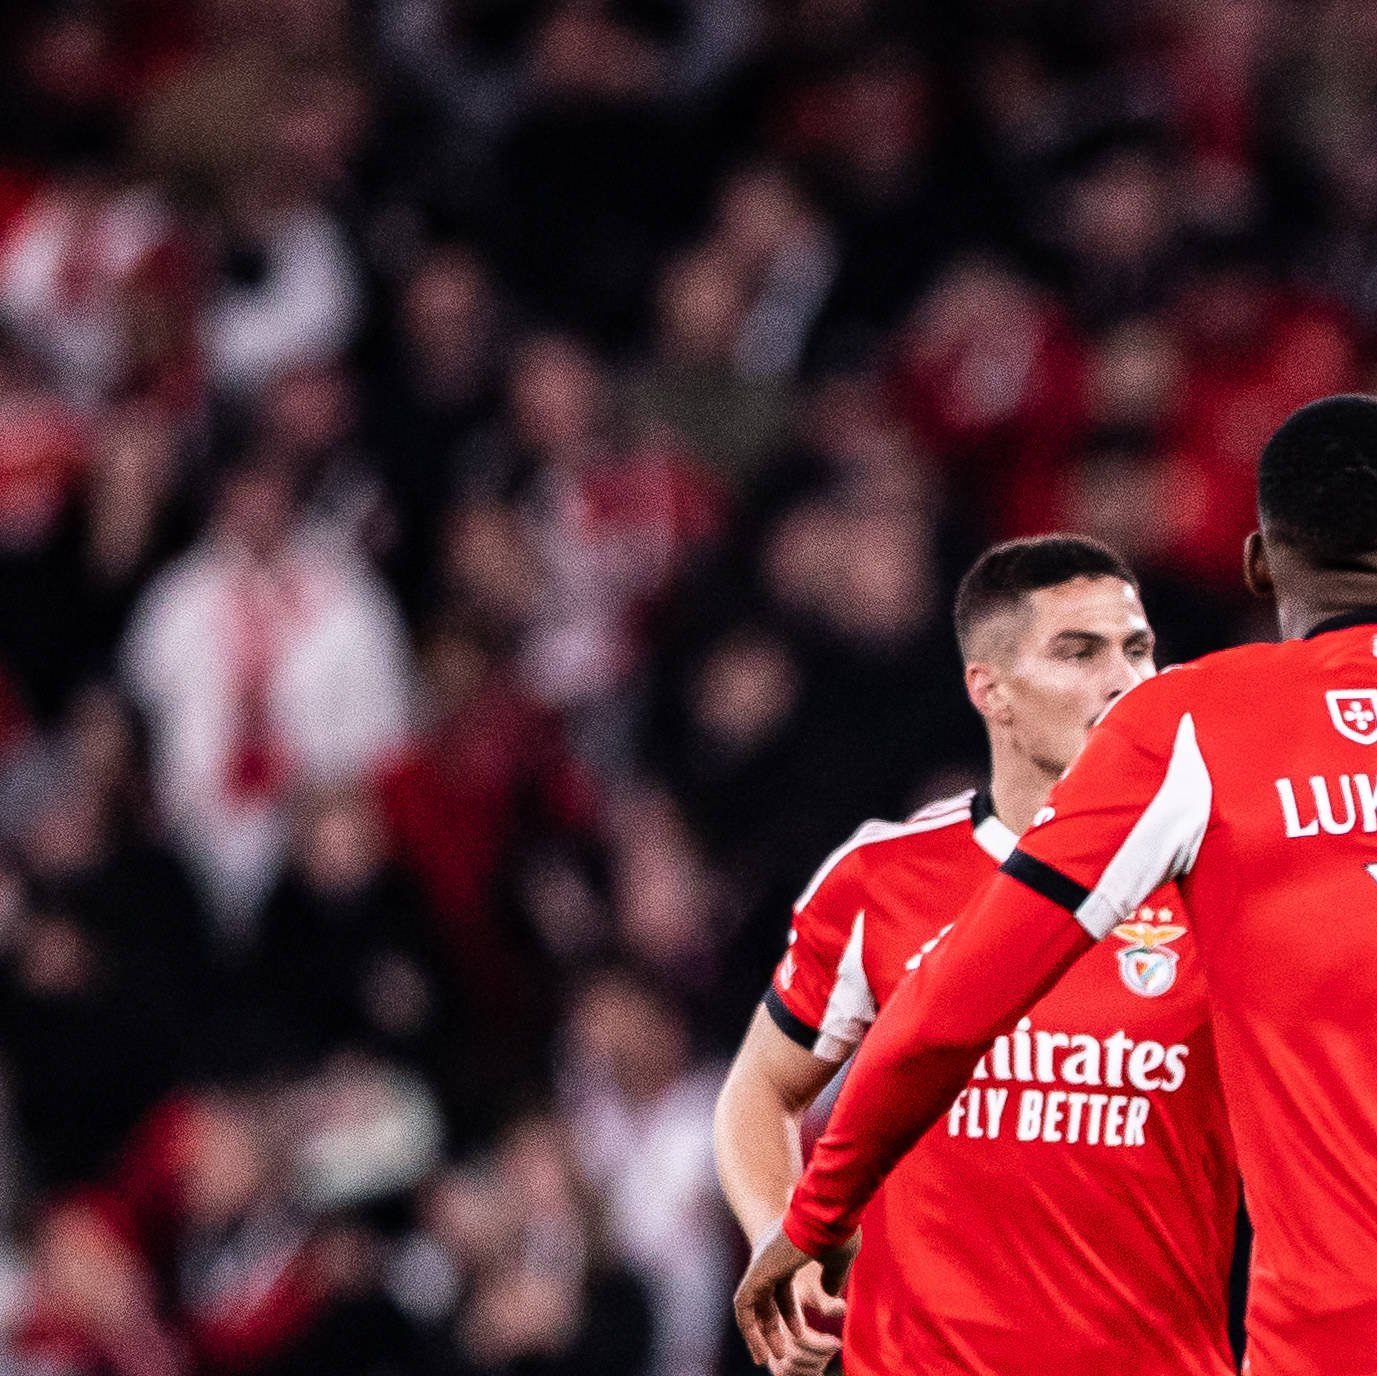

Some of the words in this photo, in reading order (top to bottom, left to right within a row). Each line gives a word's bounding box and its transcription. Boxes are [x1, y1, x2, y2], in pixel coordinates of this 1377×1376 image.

[972, 1015, 1190, 1092] irates
[947, 1086, 1009, 1140] FLY
[1016, 1088, 1151, 1147] BETTER
